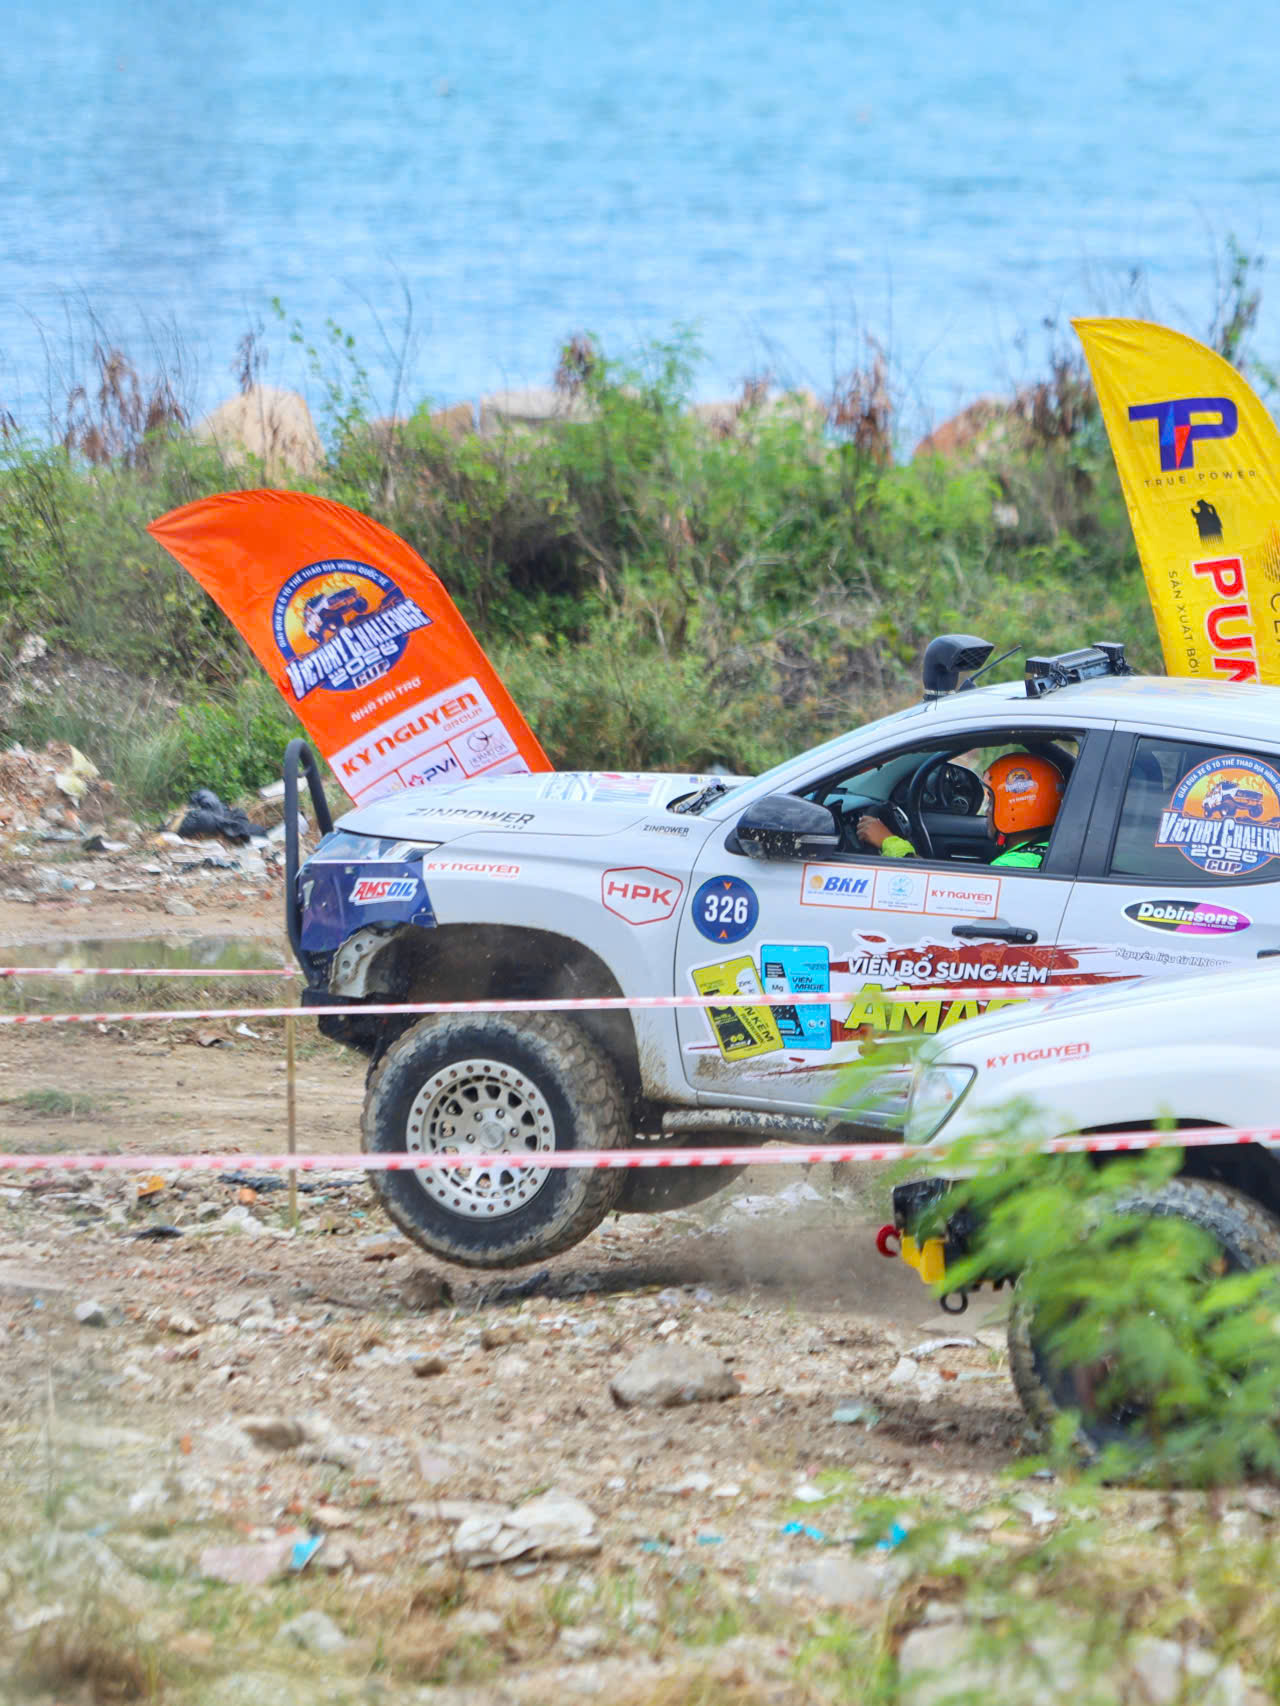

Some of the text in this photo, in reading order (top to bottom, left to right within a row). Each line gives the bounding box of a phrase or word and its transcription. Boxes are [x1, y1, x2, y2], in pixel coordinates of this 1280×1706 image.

[1128, 397, 1238, 472] TP
[1144, 470, 1257, 488] TRUE POWER
[354, 660, 391, 688] CUP
[423, 757, 457, 782] PVI
[407, 808, 536, 825] ZINPOWER
[643, 824, 690, 834] ZINPOWER
[1158, 811, 1222, 845] VICTORY
[1191, 844, 1258, 863] 2026
[1206, 860, 1242, 873] CUP
[355, 881, 414, 899] AMSOIL
[607, 881, 672, 906] HPK
[824, 876, 869, 893] BKH
[705, 895, 748, 924] 326
[1137, 903, 1239, 926] Dobinsons
[848, 953, 1049, 983] VIÊN BỔ SUNG KẼM
[772, 984, 784, 992] Mg
